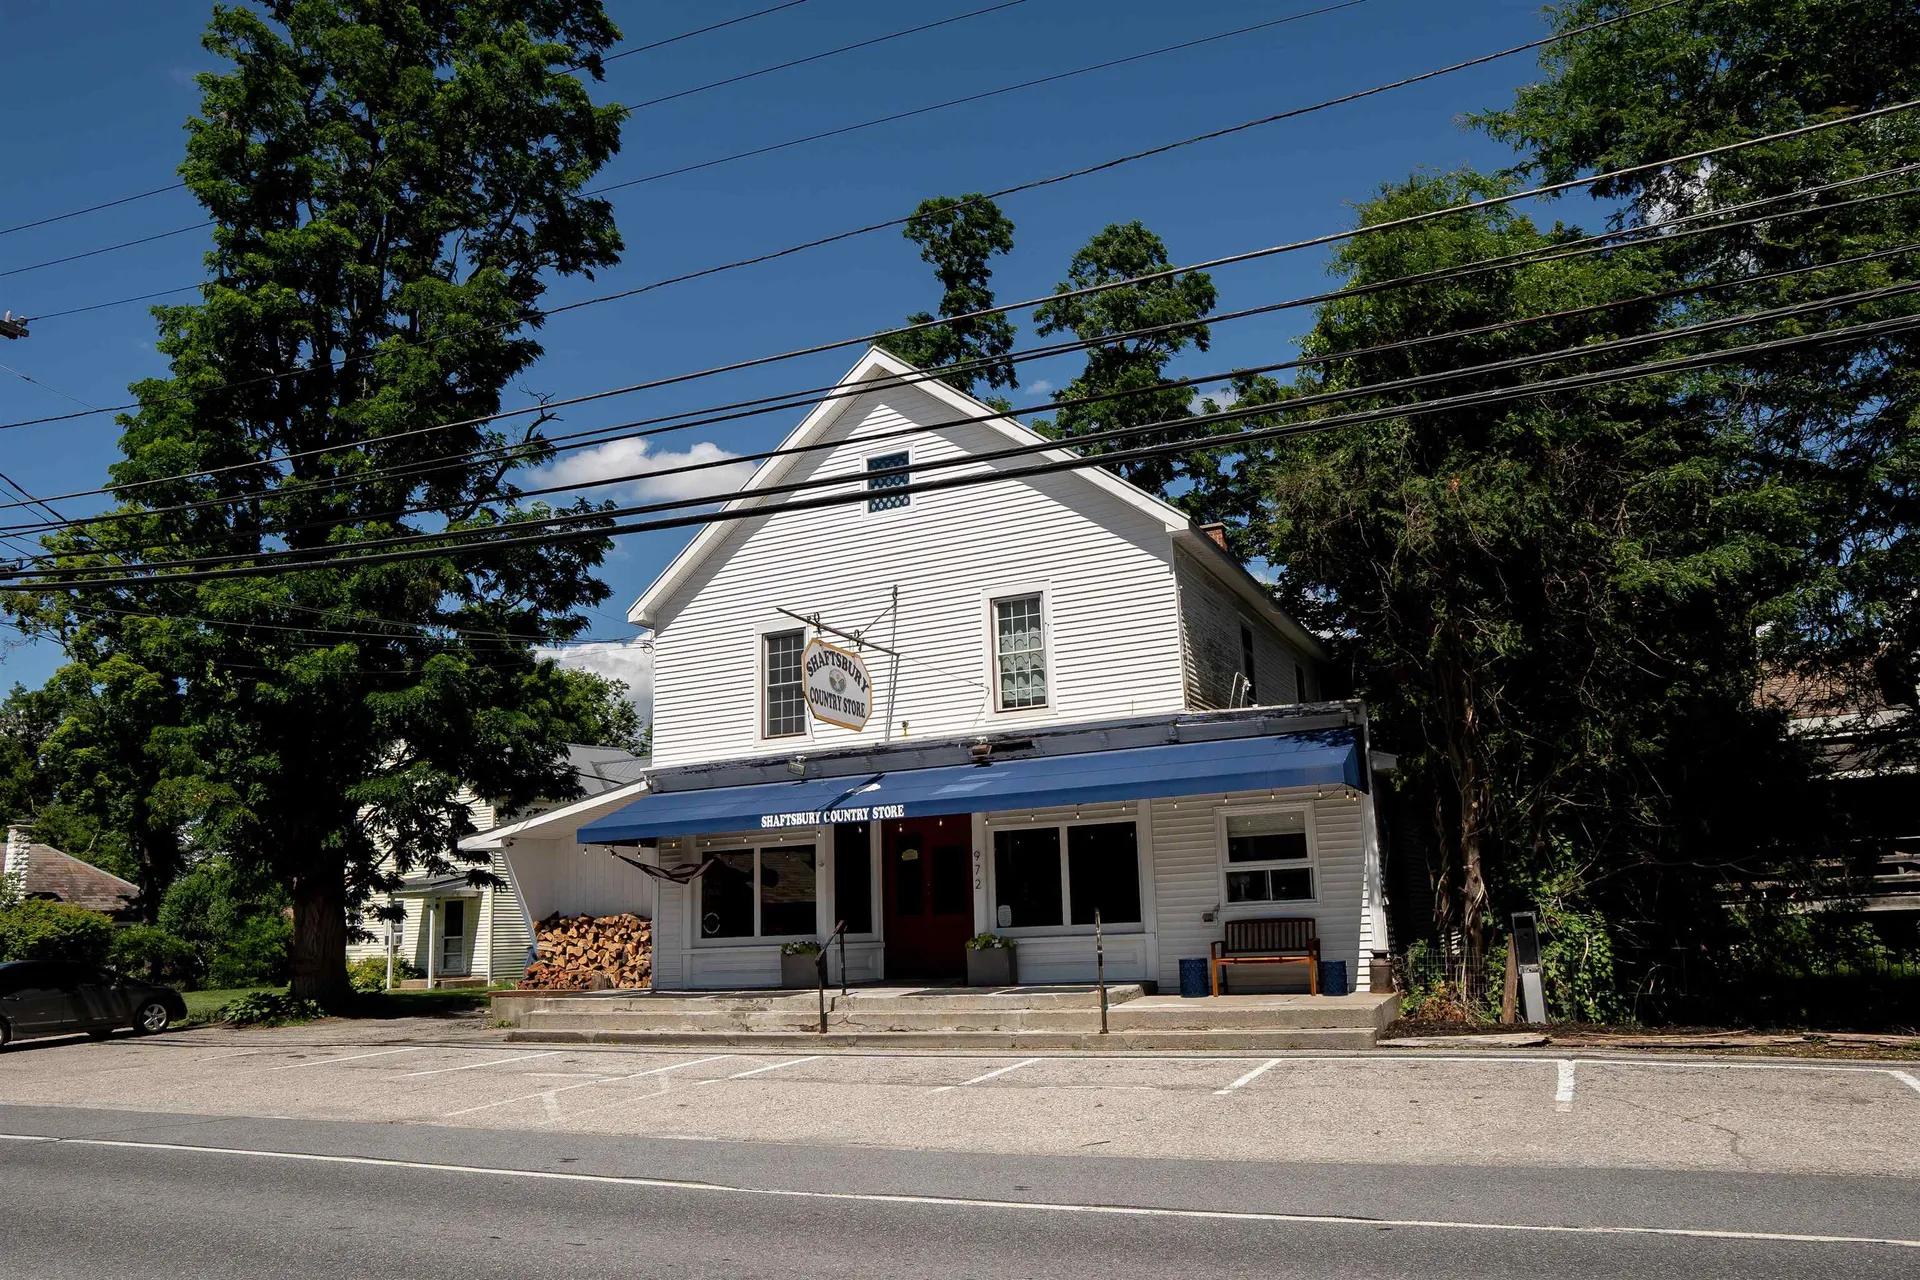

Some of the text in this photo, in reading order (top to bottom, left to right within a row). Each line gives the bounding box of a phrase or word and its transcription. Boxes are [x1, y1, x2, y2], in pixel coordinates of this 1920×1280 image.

[806, 650, 870, 693] SHAFTSBURY
[809, 686, 866, 718] COUNTRY STORE
[761, 804, 905, 828] SHAFTSBURY COUNTRY STORE
[973, 850, 982, 890] 972
